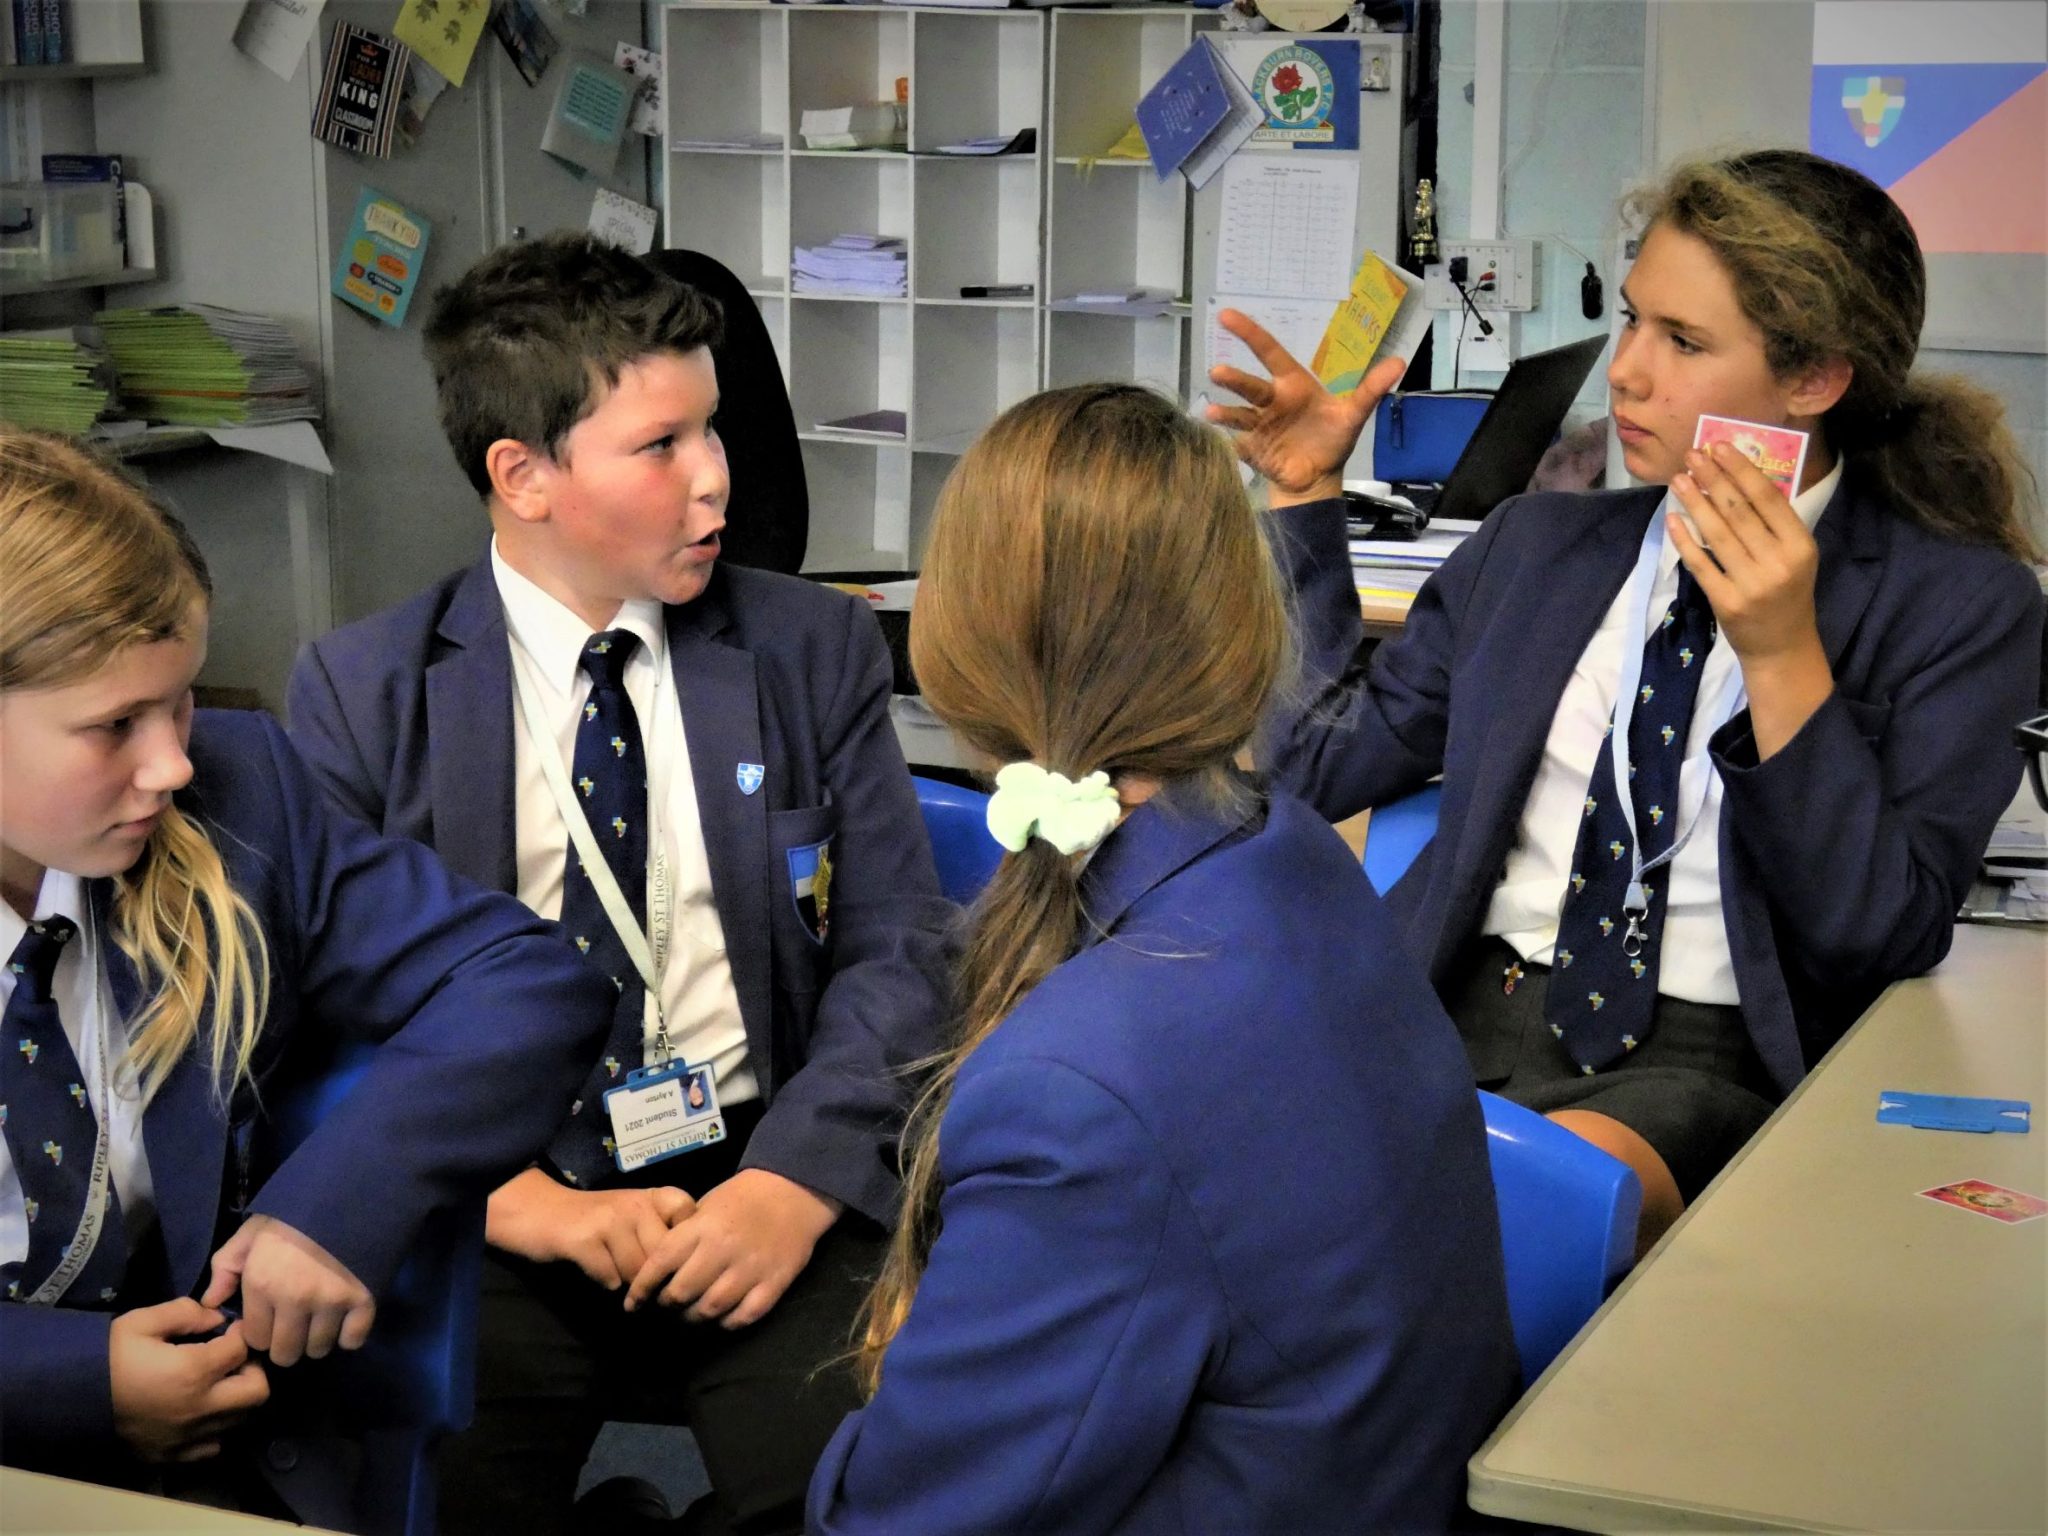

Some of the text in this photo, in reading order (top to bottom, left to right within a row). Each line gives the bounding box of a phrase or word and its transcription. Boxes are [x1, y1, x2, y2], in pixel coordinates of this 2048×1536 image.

[340, 81, 379, 109] KING
[1254, 131, 1330, 139] ARTE ET LABORE
[1346, 291, 1381, 345] THANKS
[653, 853, 665, 905] THOMAS
[624, 1108, 678, 1132] Student 2021
[93, 1131, 109, 1183] RIPLEY
[624, 1145, 663, 1164] THOMAS
[57, 1213, 96, 1277] THOMAS
